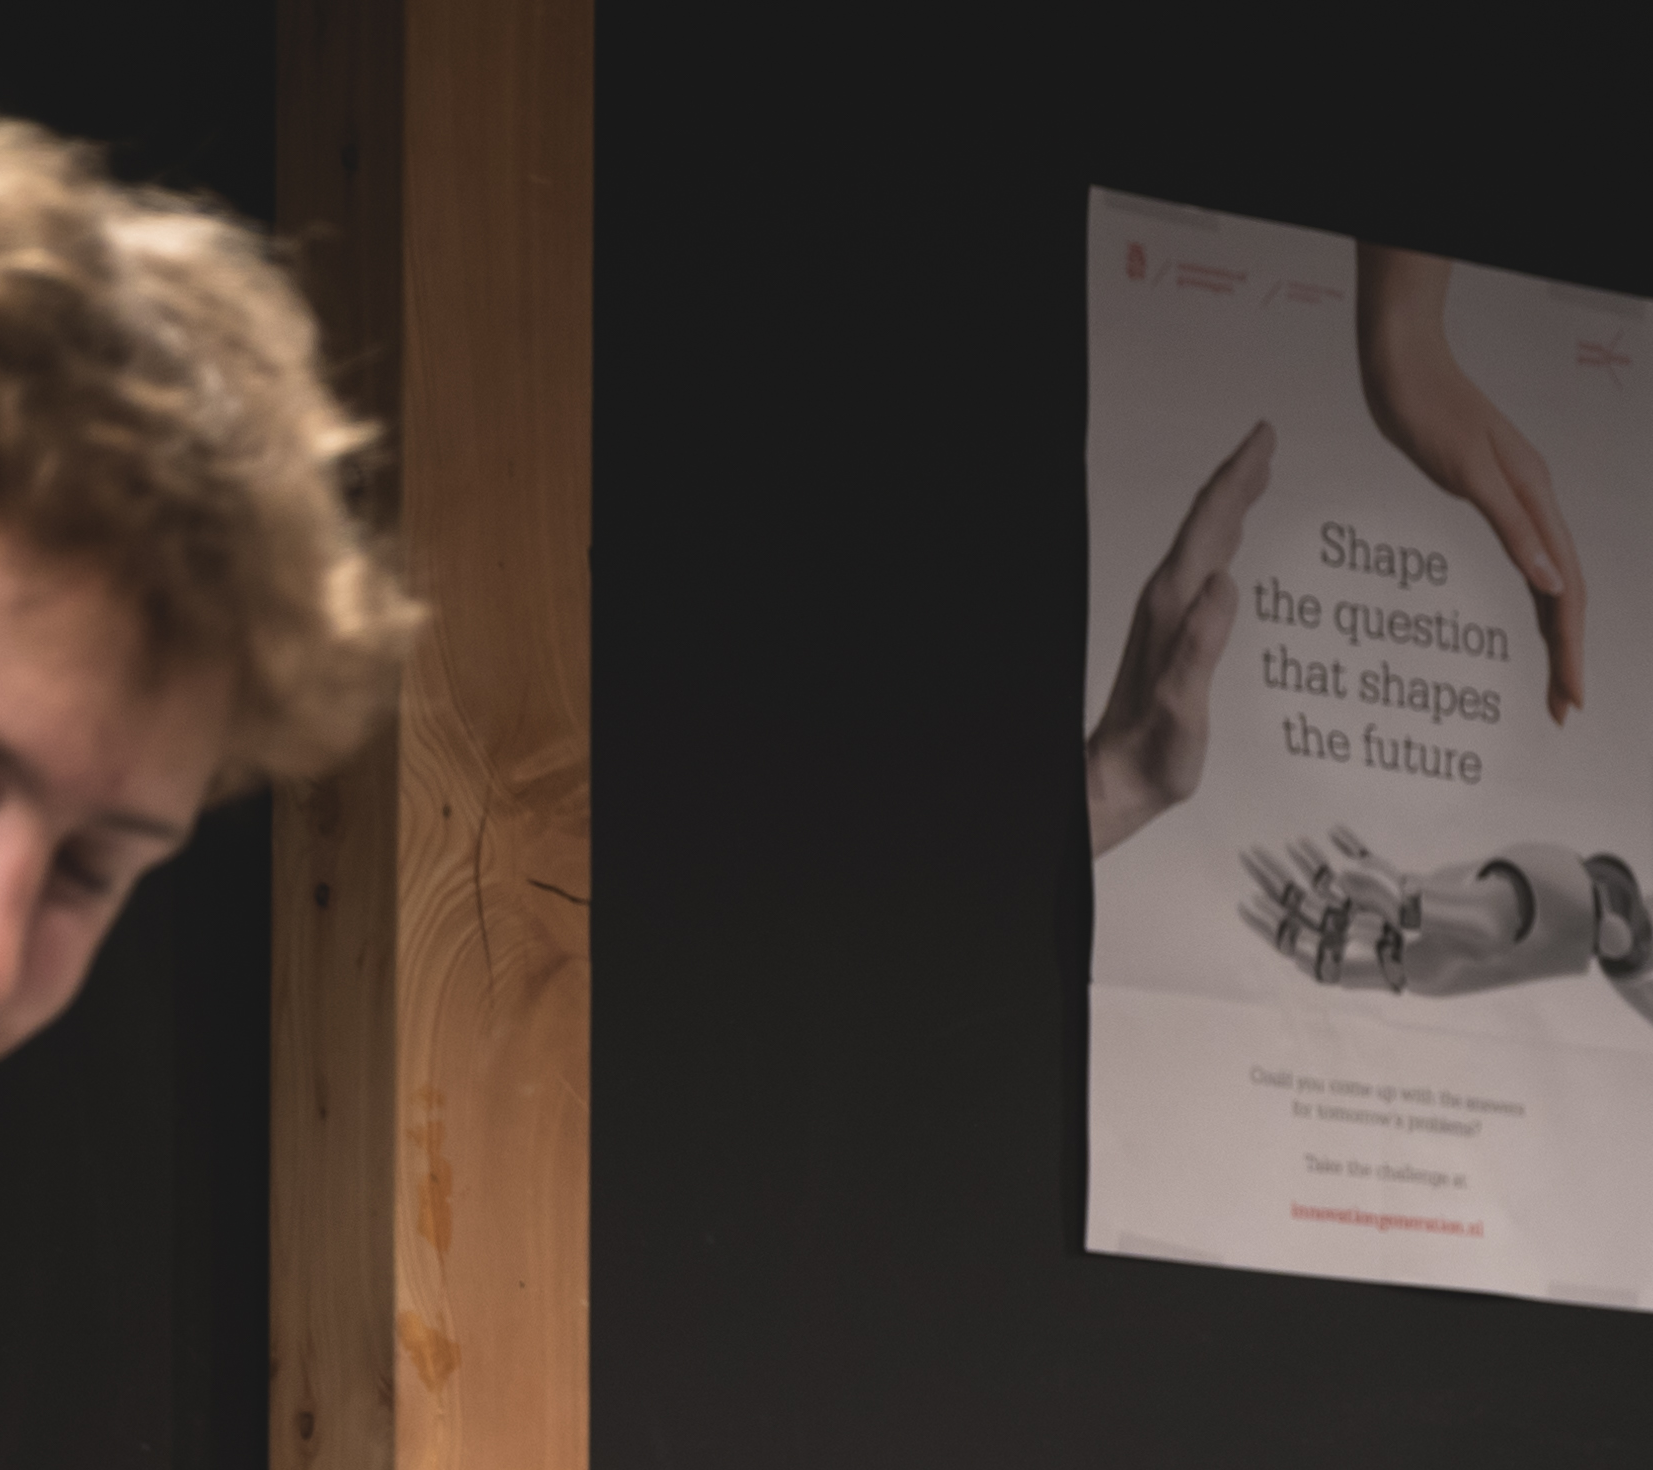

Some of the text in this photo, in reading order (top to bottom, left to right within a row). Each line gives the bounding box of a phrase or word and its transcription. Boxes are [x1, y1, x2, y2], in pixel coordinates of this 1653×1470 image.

[1320, 520, 1448, 590] Shape
[1254, 576, 1510, 662] the question
[1262, 643, 1502, 726] that shapes
[1281, 711, 1483, 785] the future
[1249, 1065, 1294, 1090] Could
[1296, 1076, 1325, 1095] you
[1377, 1084, 1398, 1104] up
[1400, 1086, 1433, 1106] with
[1438, 1089, 1462, 1109] the
[1303, 1152, 1344, 1176] Take
[1346, 1158, 1373, 1178] the
[1375, 1160, 1450, 1189] challenge
